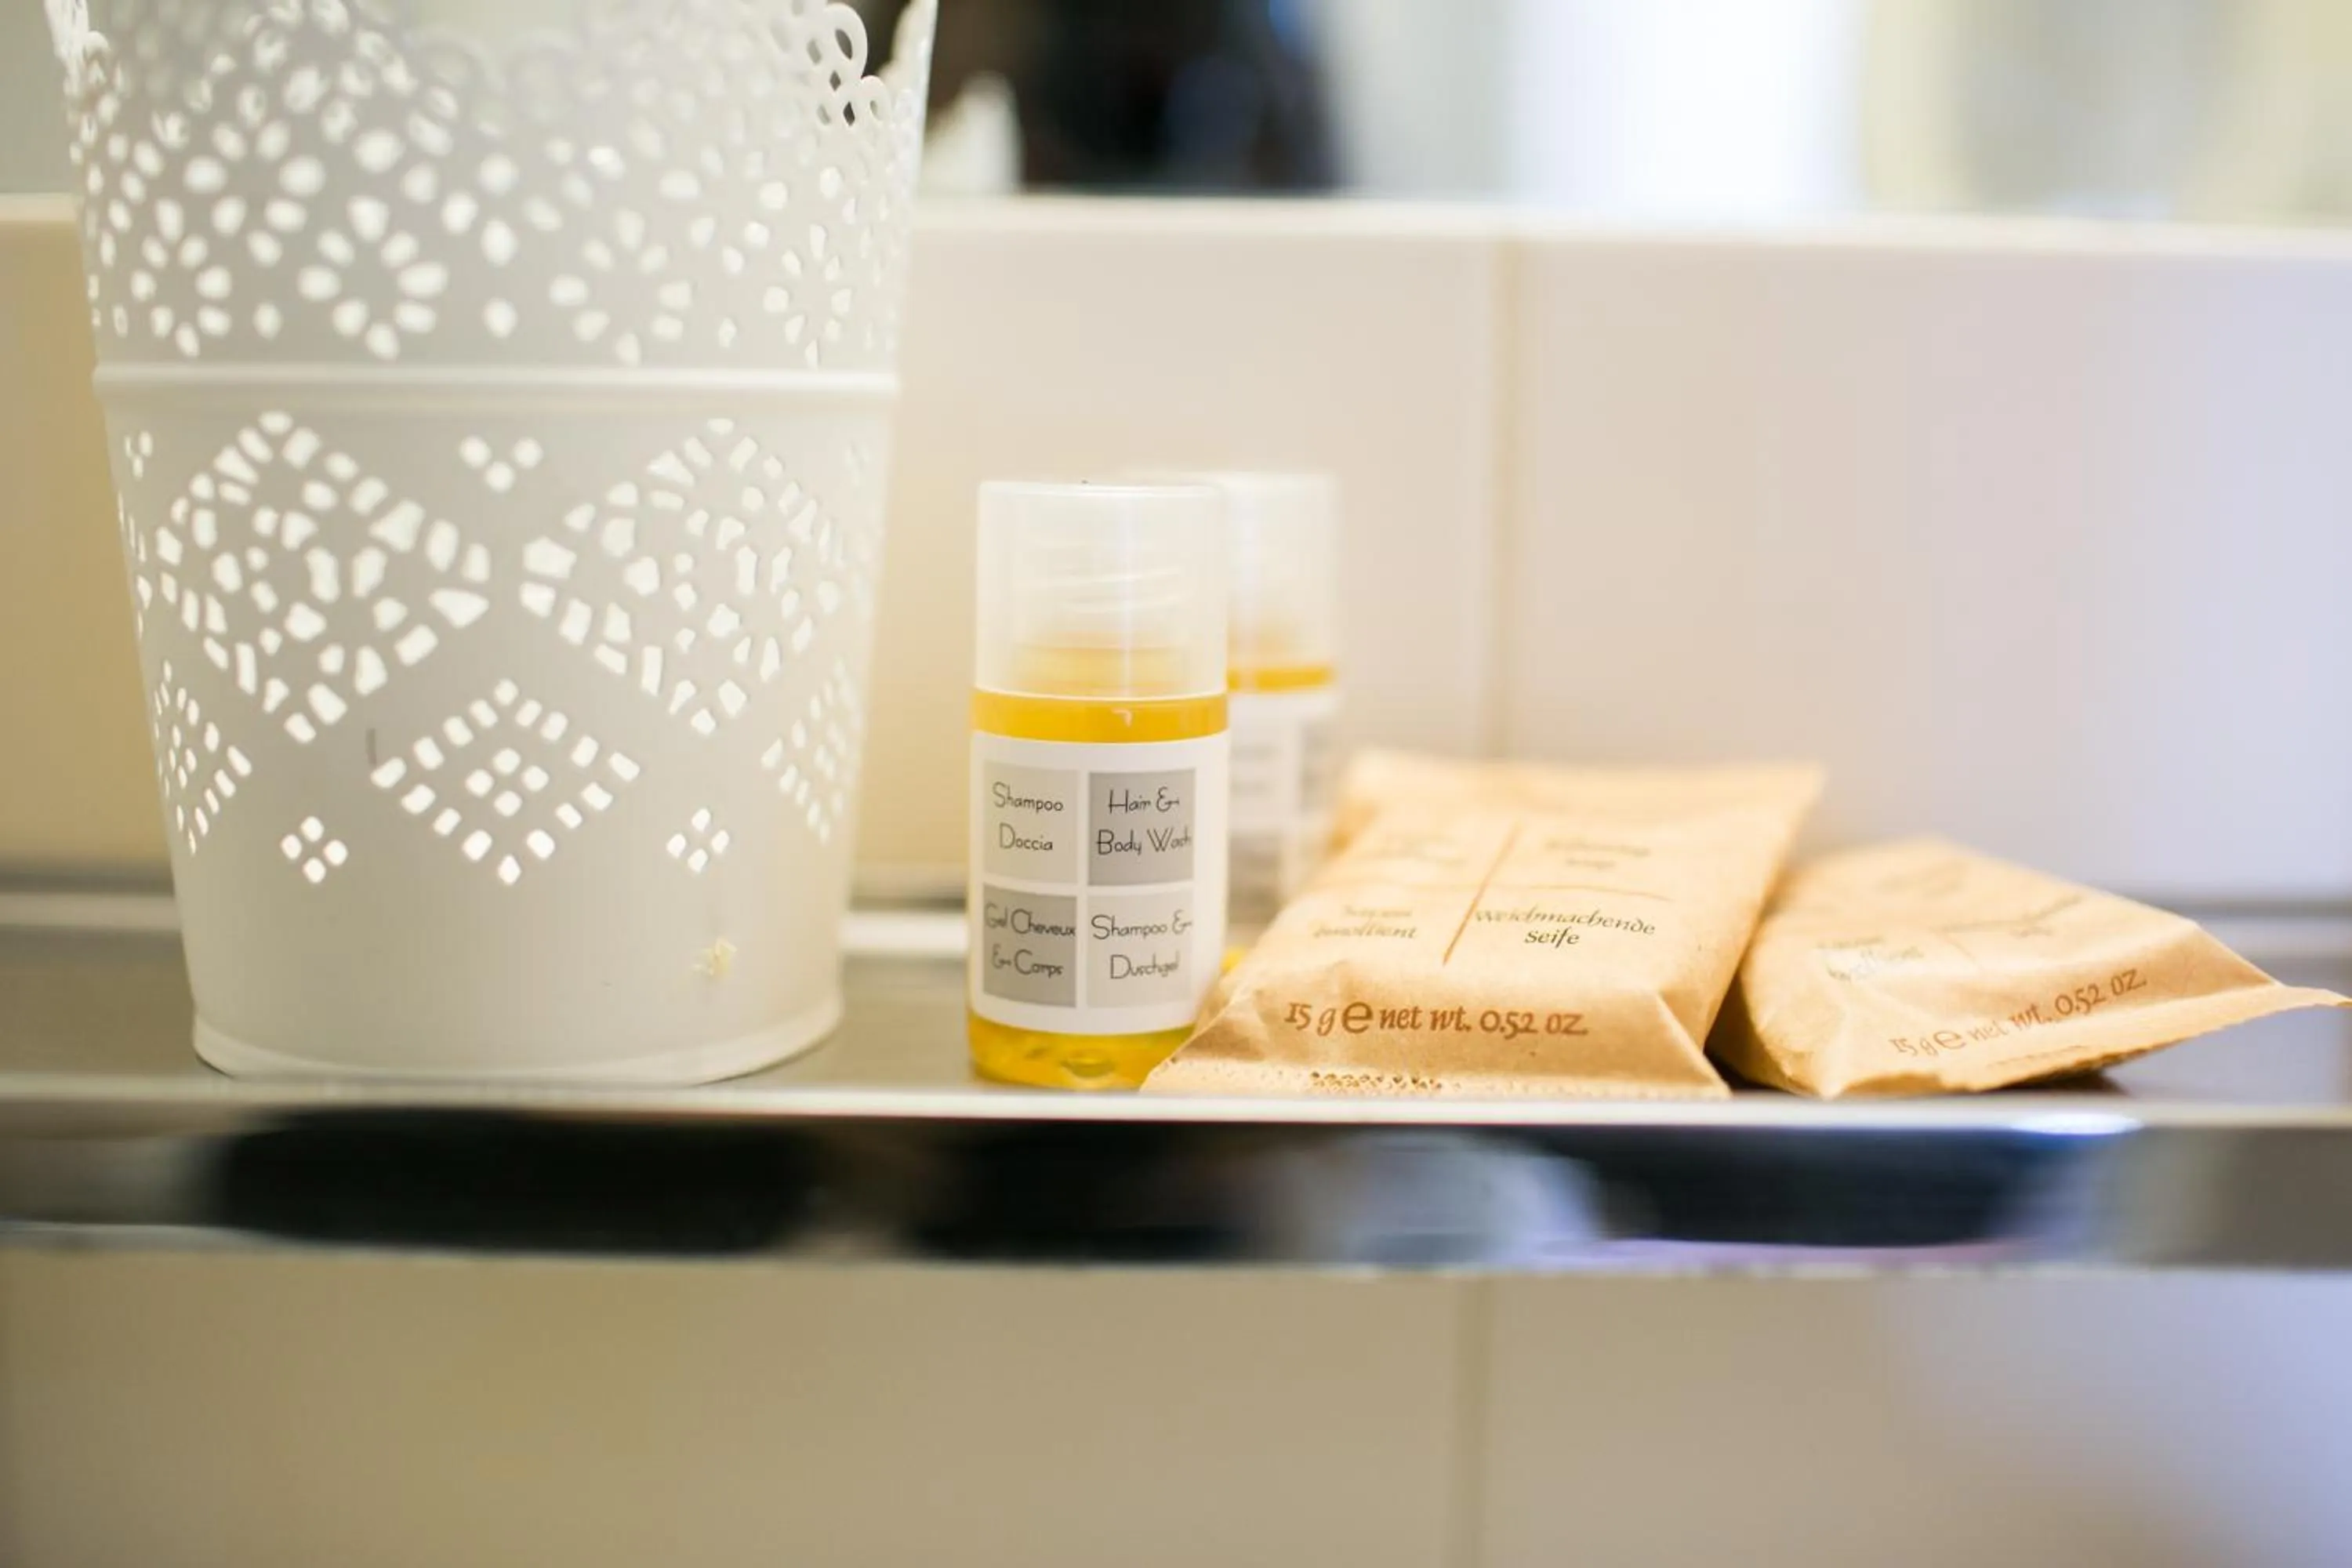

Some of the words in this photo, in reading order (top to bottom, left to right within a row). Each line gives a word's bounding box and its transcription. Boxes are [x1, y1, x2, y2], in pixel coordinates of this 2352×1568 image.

[992, 781, 1064, 815] Shampoo
[1108, 788, 1151, 815] Hair
[1156, 786, 1180, 813] &
[999, 822, 1053, 851] Doccia
[1097, 828, 1142, 855] Body
[1091, 913, 1167, 940] Shampoo
[1014, 948, 1064, 978] Corps
[1286, 1002, 1312, 1030] 15
[1378, 1005, 1423, 1031] net
[1429, 1006, 1472, 1033] wt.
[1479, 1009, 1538, 1040] 0.52
[1967, 1019, 2010, 1042] net
[2054, 982, 2107, 1017] 0.52
